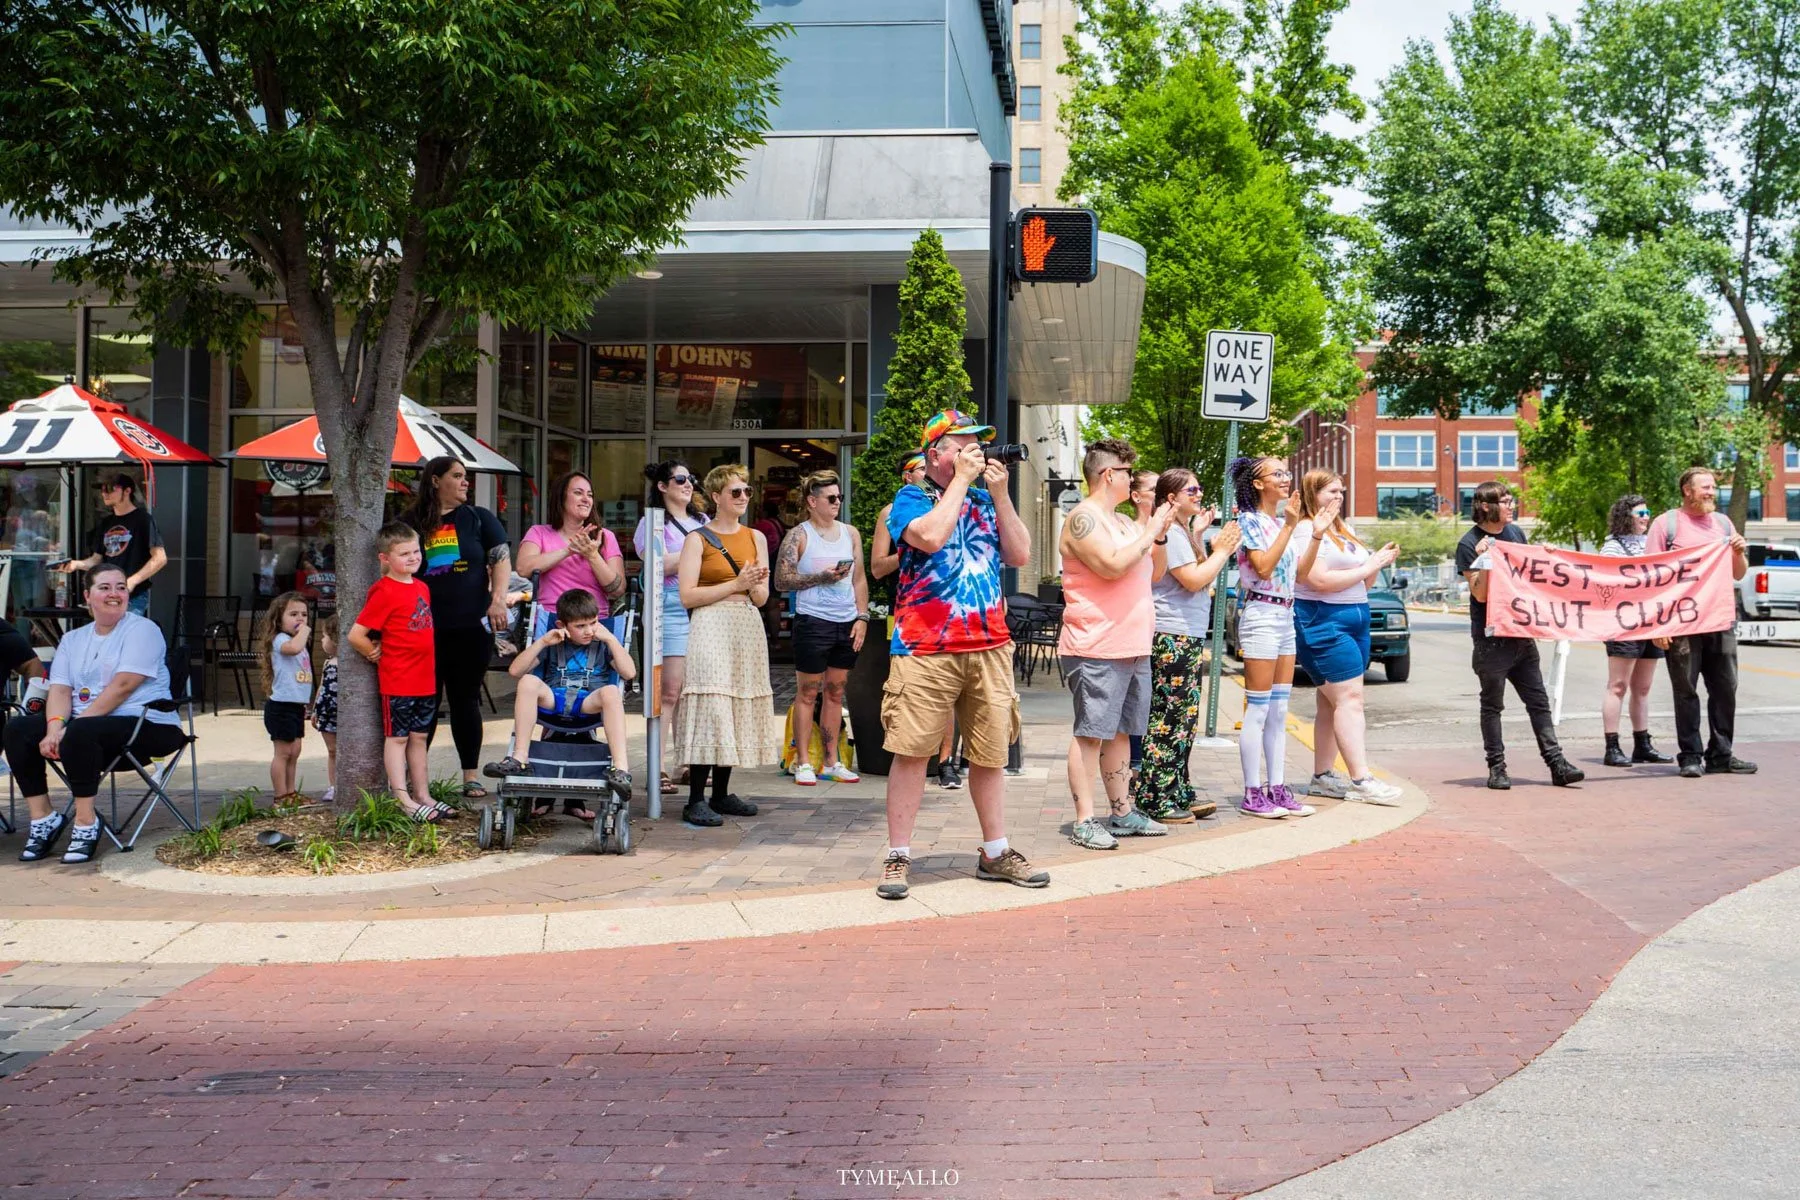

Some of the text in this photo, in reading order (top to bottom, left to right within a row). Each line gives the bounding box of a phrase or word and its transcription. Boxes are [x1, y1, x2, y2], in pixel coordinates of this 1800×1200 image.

[670, 345, 753, 369] JOHN'S
[1217, 338, 1263, 360] ONE
[1213, 362, 1264, 385] WAY
[0, 417, 75, 455] JJ
[735, 419, 761, 430] 330A
[1503, 552, 1702, 590] WEST SIDE
[1511, 596, 1699, 631] SLUT CLUB
